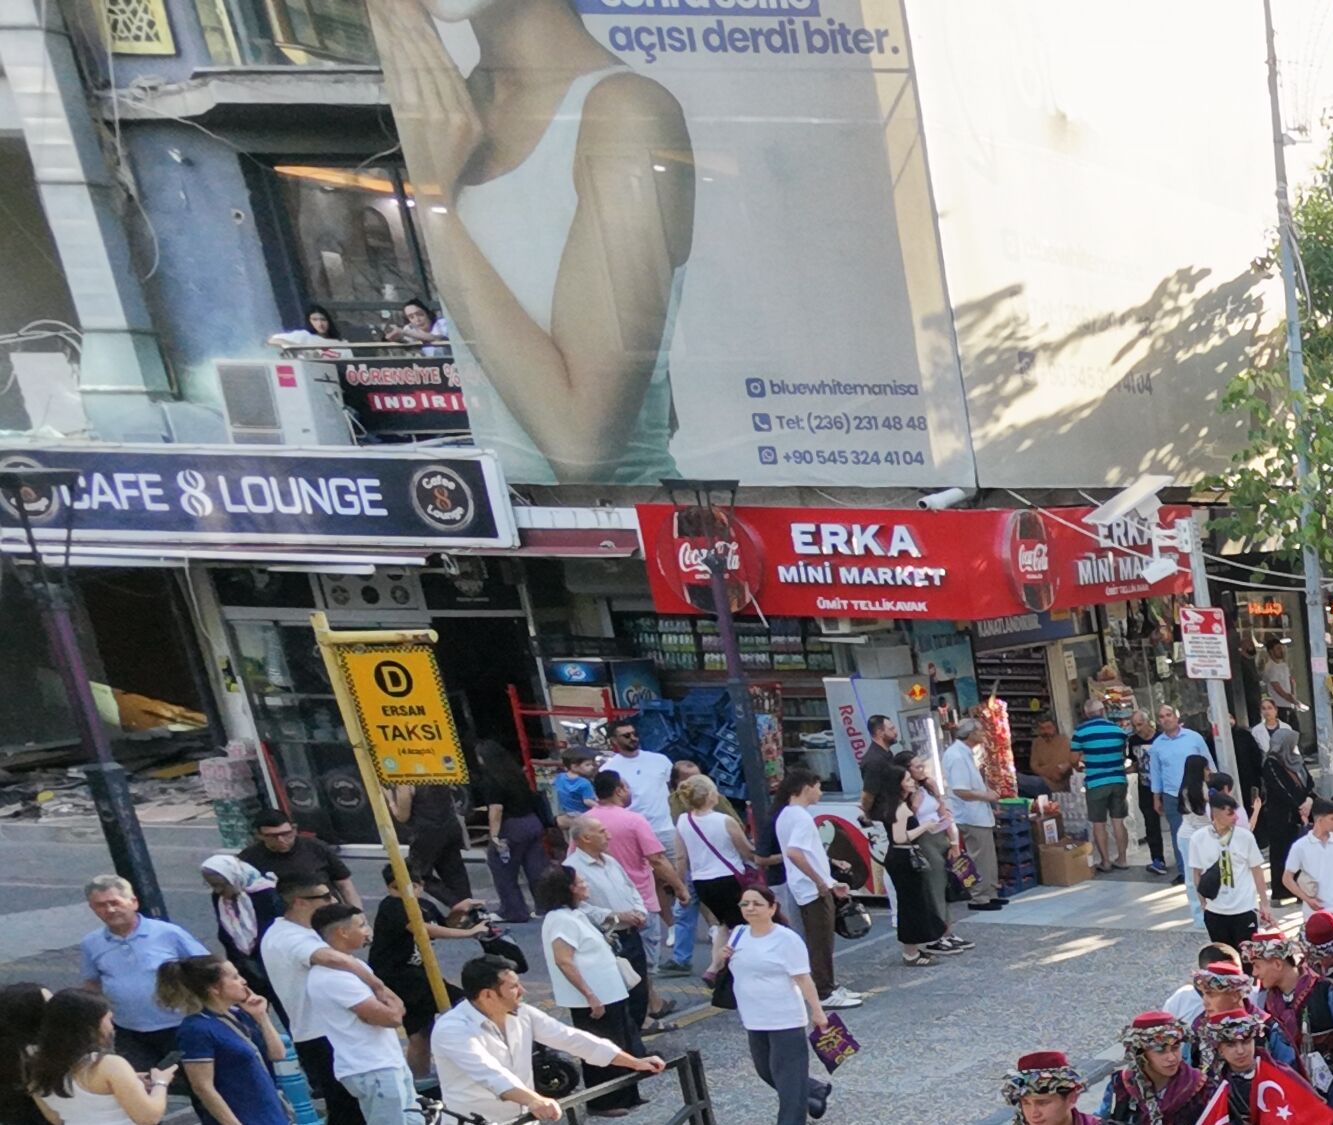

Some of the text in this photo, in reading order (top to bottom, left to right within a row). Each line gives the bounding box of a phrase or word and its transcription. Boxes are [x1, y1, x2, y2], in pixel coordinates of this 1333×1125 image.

[608, 18, 901, 63] açısı derdi biter.
[769, 379, 919, 396] bluewhitemanisa
[807, 411, 850, 434] (236)
[854, 416, 878, 431] 231
[882, 416, 903, 431] 48
[906, 416, 928, 431] 48
[783, 450, 813, 465] +90
[816, 450, 848, 465] 545
[851, 450, 881, 466] 324
[61, 472, 170, 511] CAFE
[218, 474, 389, 516] LOUNGE
[790, 522, 922, 557] ERKA
[777, 561, 946, 587] MİNİ MARKET
[1077, 551, 1116, 586] MİNİ
[816, 597, 849, 610] ÜMİT
[381, 665, 407, 693] D
[381, 705, 426, 717] ERSAN
[838, 704, 862, 737] Red
[375, 720, 443, 741] TAKSİ
